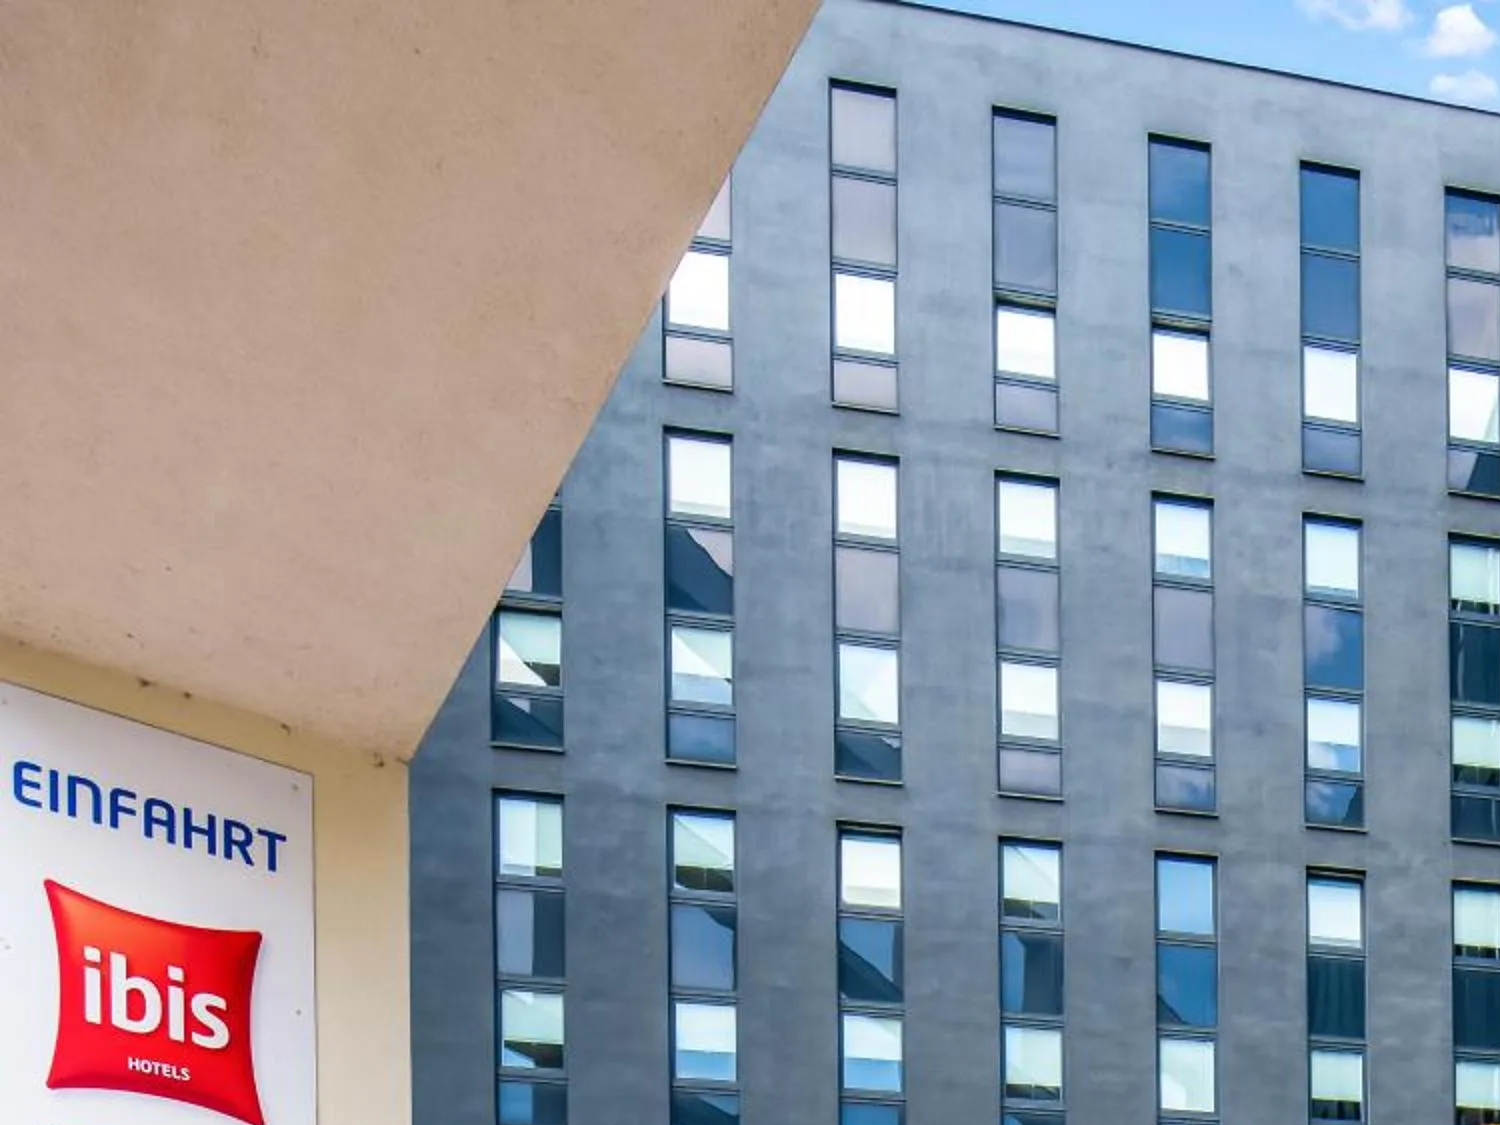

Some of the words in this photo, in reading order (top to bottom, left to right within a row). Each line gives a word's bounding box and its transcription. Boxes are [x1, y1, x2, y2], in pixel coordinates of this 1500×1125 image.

[12, 761, 287, 873] EINFAHRT
[83, 945, 231, 1050] ibis
[127, 1056, 191, 1082] HOTELS
